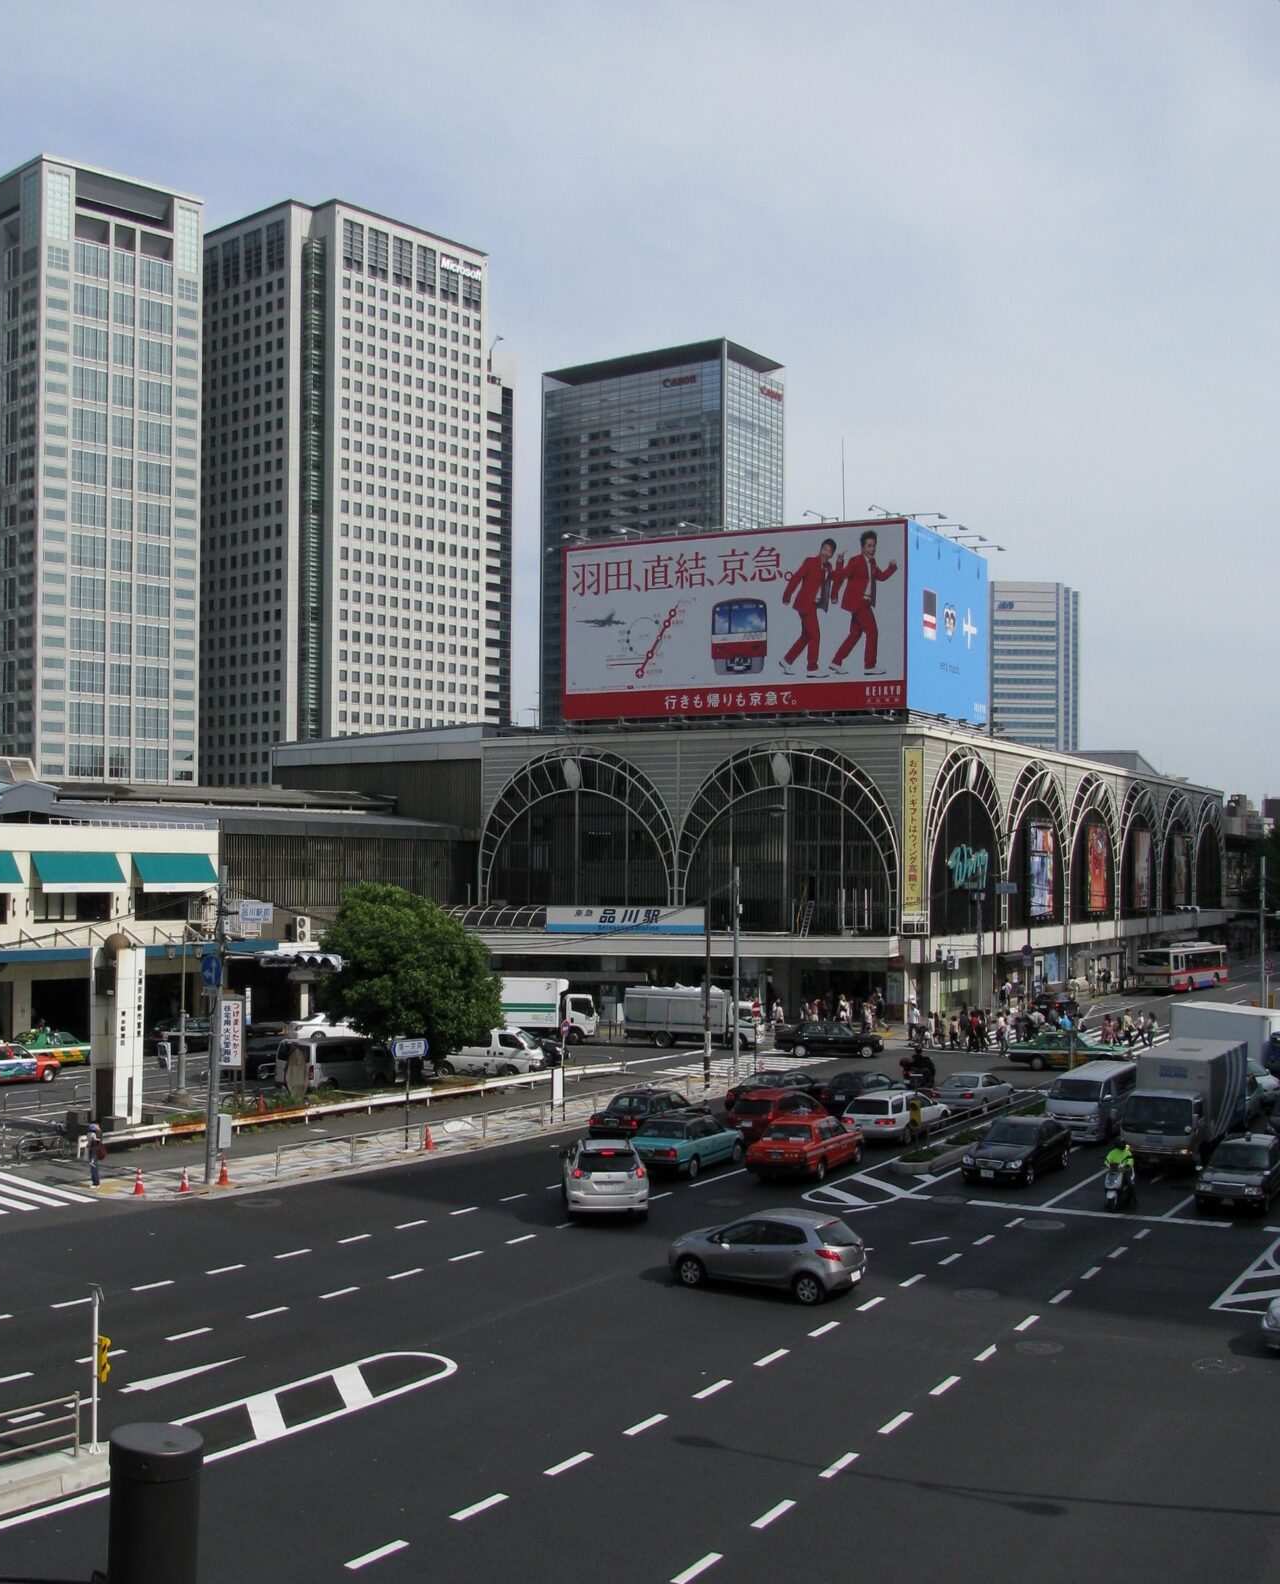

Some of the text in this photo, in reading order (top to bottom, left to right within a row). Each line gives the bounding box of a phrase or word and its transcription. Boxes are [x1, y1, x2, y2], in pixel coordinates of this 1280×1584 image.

[441, 256, 482, 281] Microsoft
[662, 375, 697, 388] Canon
[865, 685, 901, 697] KEIKYU
[664, 690, 797, 710] 行きも帰りも京急で。
[574, 908, 661, 924] 京急 品川駅
